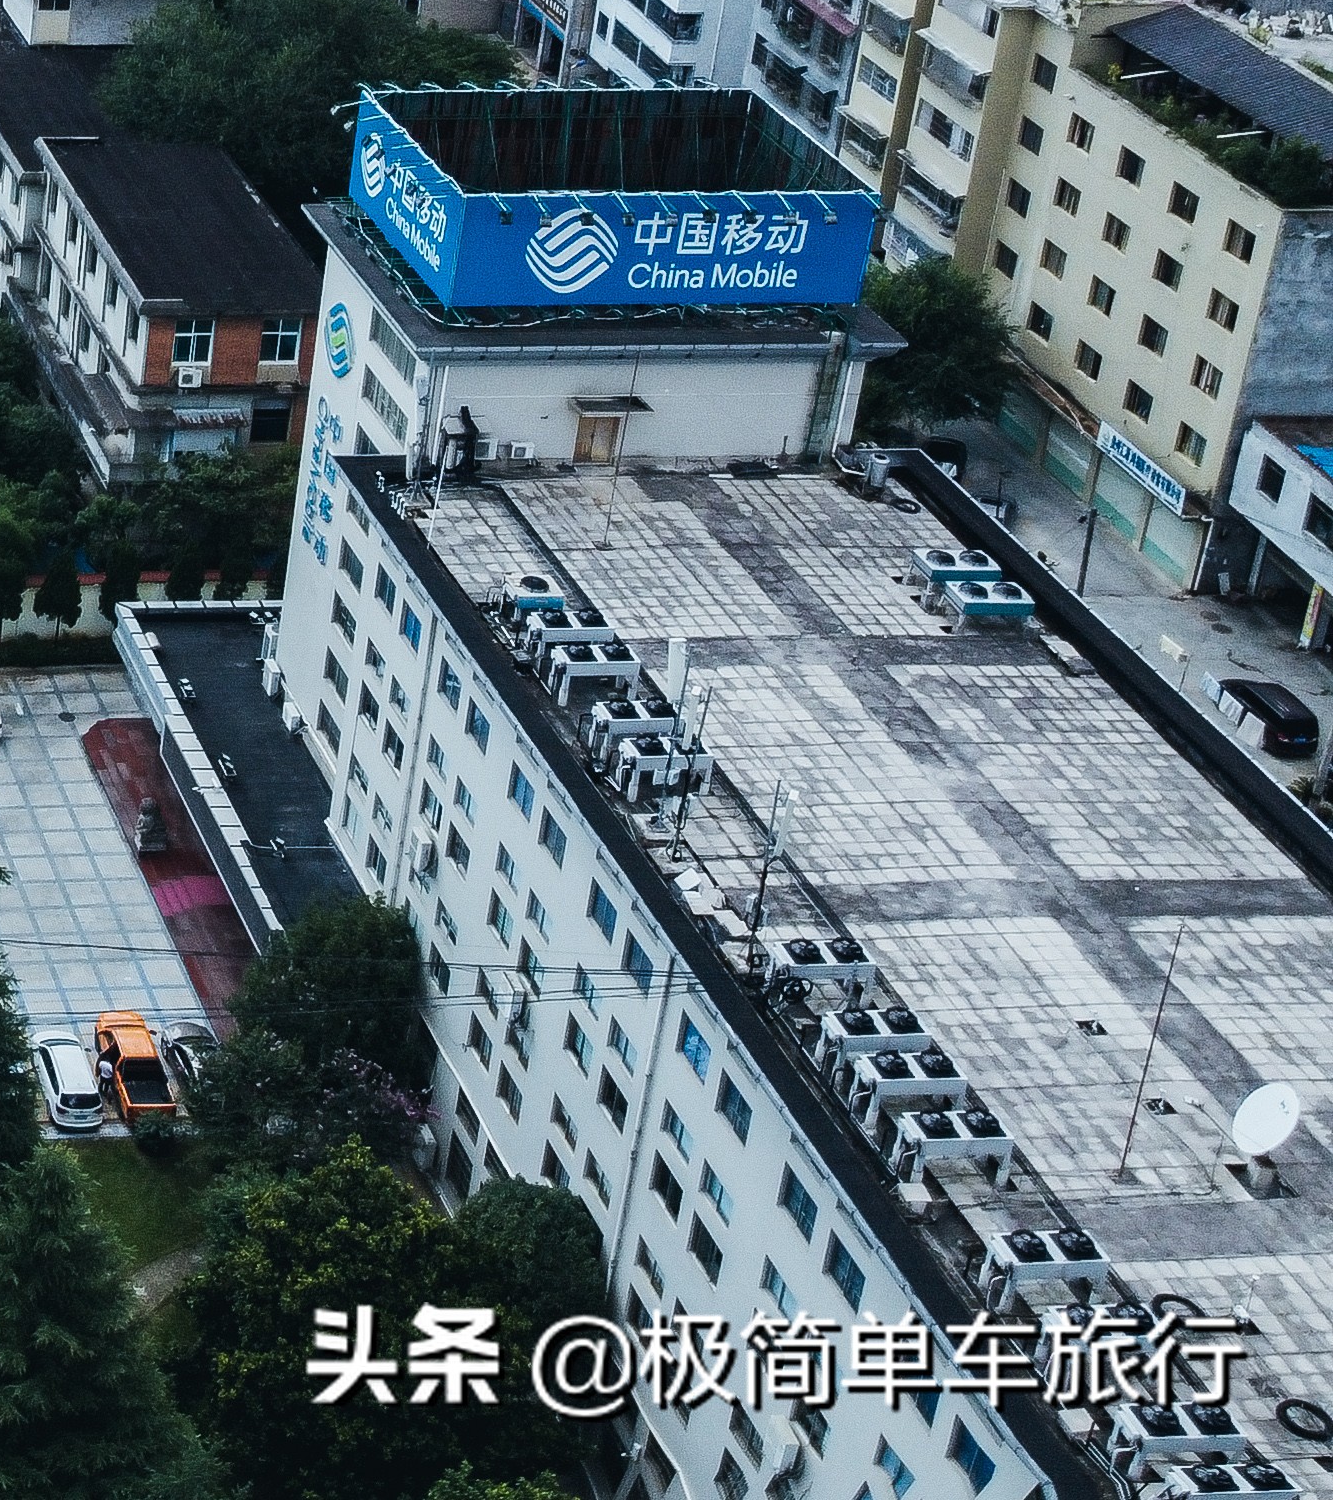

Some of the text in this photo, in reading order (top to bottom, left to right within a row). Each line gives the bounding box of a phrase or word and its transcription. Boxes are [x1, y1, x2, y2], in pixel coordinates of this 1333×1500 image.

[386, 197, 441, 273] China Mobile
[634, 211, 808, 256] 中国移动
[628, 262, 798, 291] China Mobile
